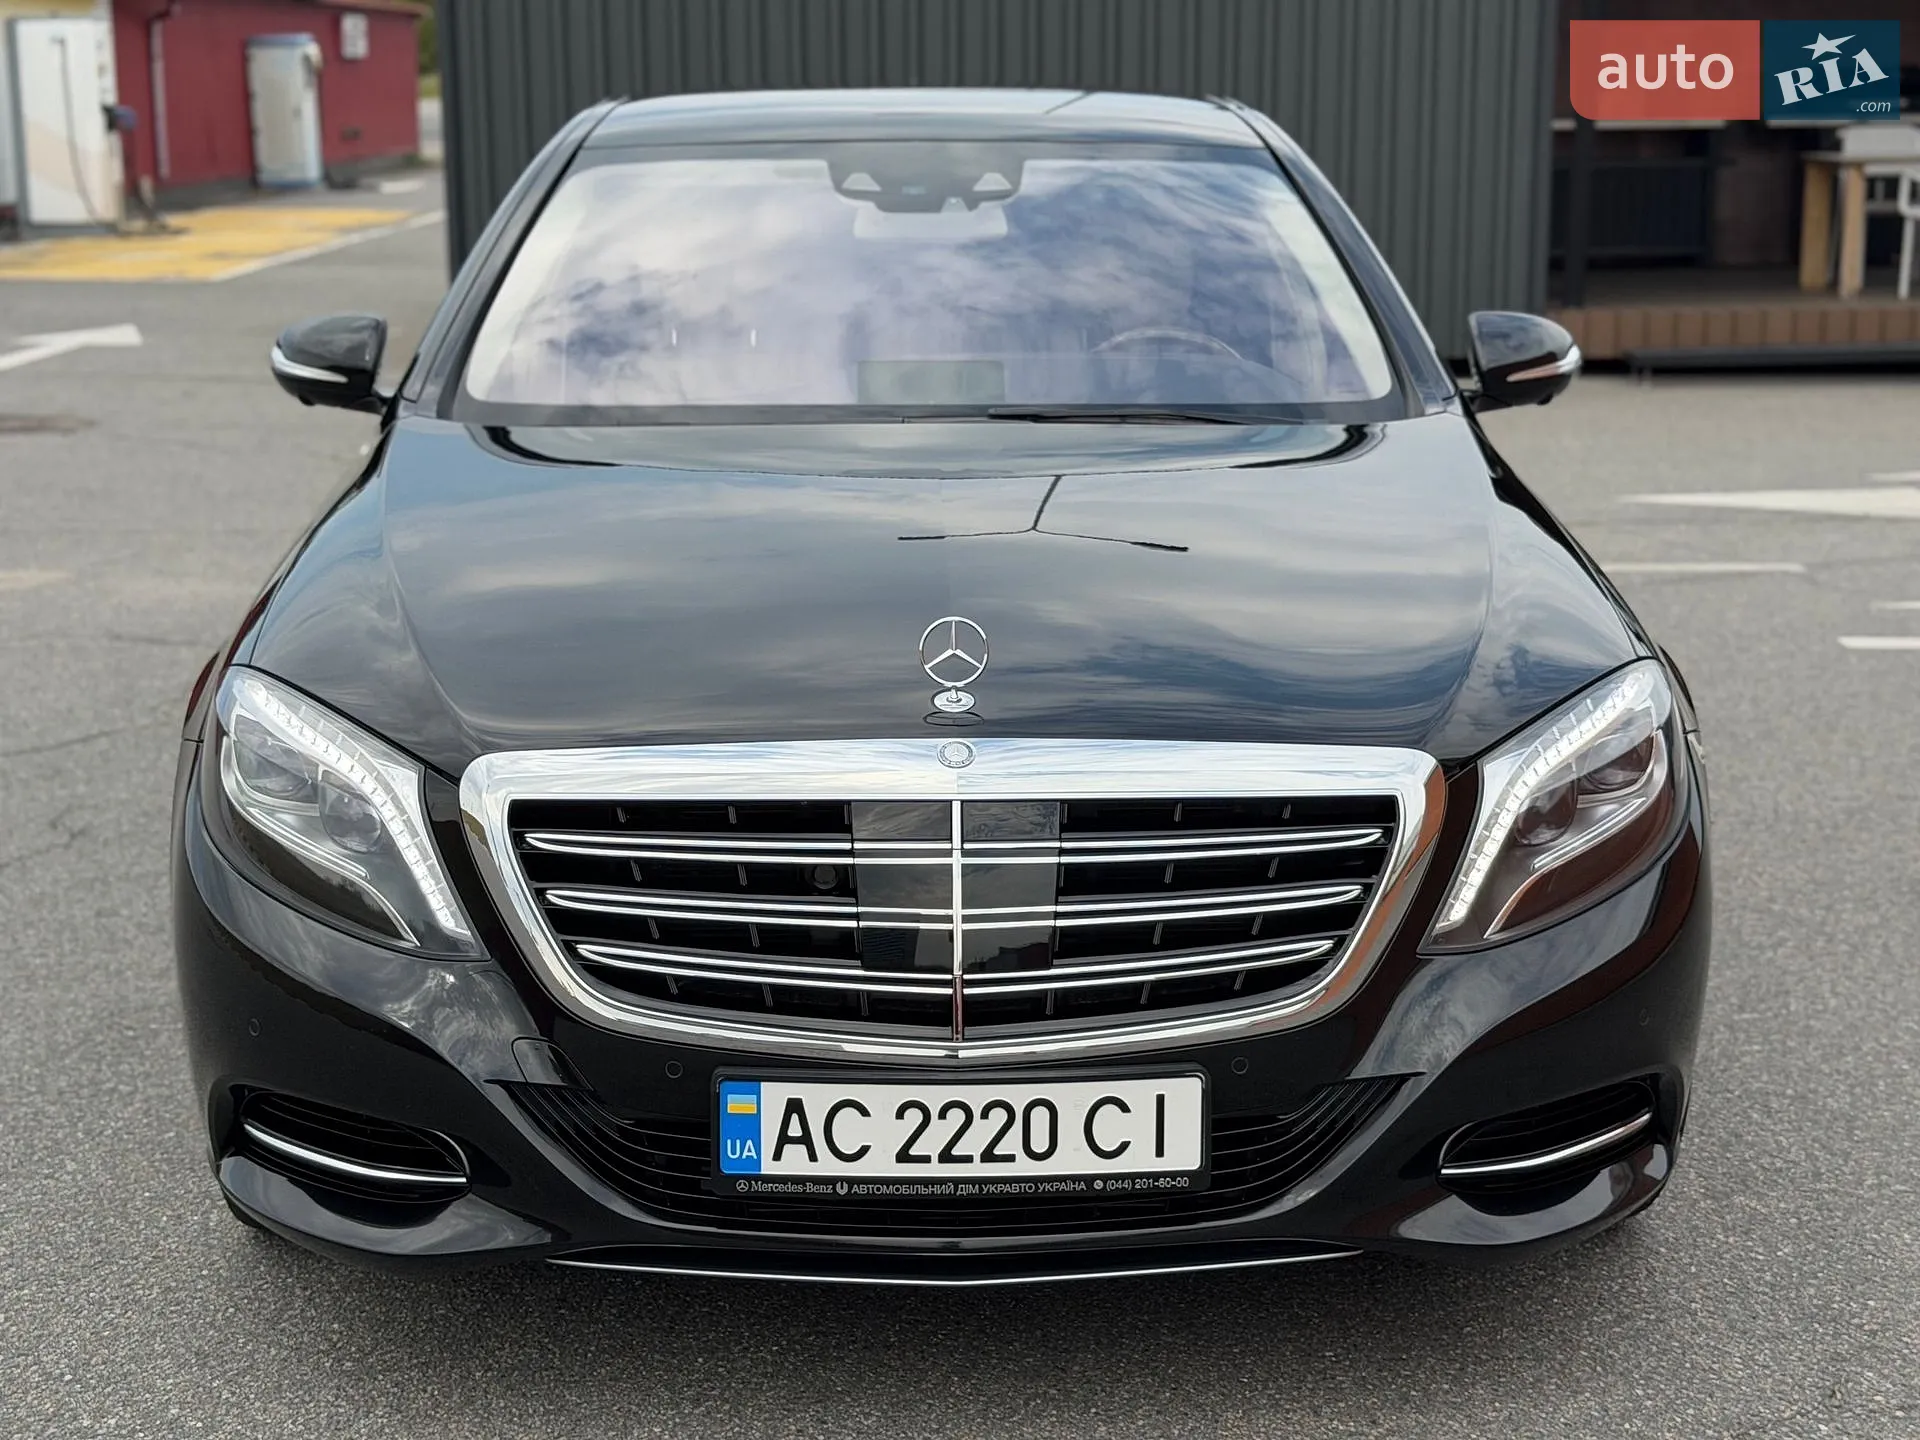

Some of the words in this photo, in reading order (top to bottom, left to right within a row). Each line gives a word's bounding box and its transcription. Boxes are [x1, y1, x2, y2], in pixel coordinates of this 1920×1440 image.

[771, 1096, 873, 1163] AC
[894, 1097, 1059, 1164] 2220
[726, 1138, 758, 1160] UA
[750, 1180, 833, 1194] Mercedes-Benz
[851, 1182, 955, 1196] АВТОМОБІЛЬНИЙ
[956, 1183, 980, 1197] ДІМ
[981, 1182, 1036, 1195] УКРАВТО
[1037, 1179, 1087, 1193] УКРАЇНА
[1106, 1178, 1132, 1192] (044)
